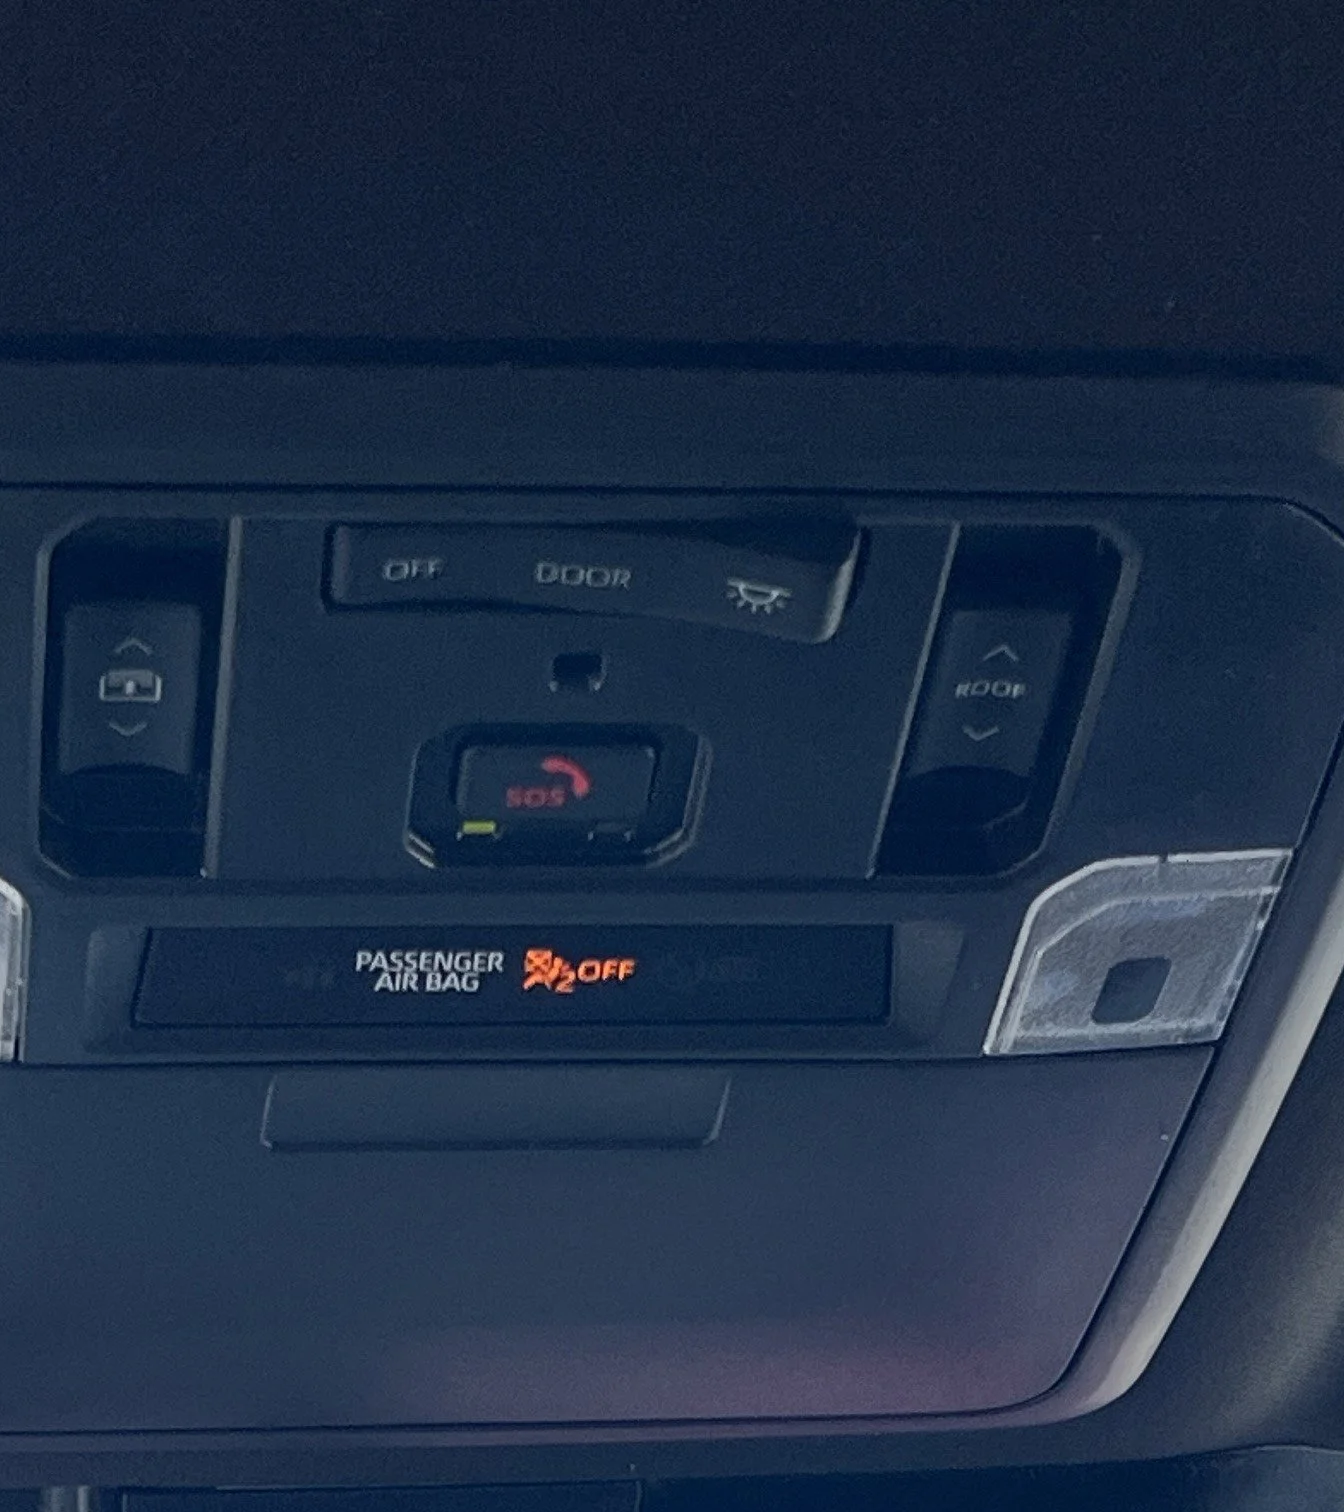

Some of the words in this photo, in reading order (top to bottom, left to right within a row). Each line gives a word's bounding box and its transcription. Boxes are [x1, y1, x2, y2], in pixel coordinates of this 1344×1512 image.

[382, 557, 445, 581] OFF
[534, 561, 633, 590] DOOR
[955, 680, 1027, 699] ROOF
[505, 787, 566, 808] SOS
[355, 950, 504, 973] PASSENGER
[577, 957, 636, 983] OFF
[373, 971, 418, 992] AIR
[425, 971, 480, 992] BAG
